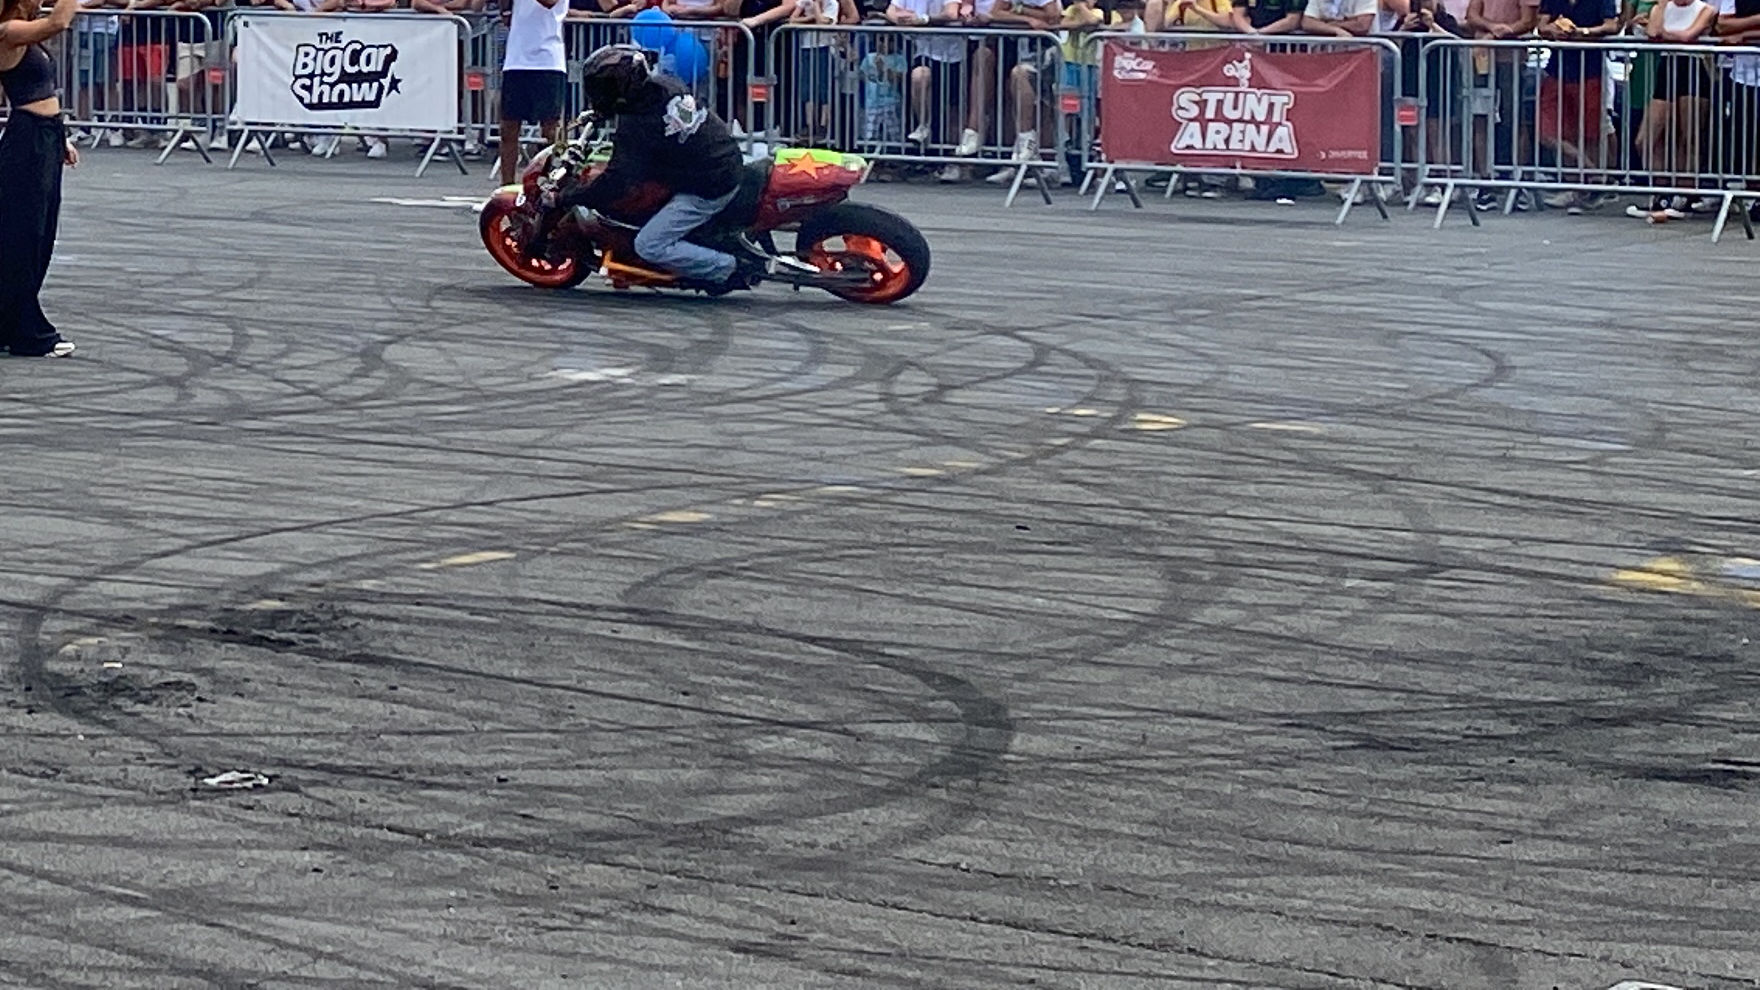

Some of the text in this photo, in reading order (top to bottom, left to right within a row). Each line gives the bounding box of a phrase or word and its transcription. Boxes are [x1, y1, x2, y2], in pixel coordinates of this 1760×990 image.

[317, 30, 344, 44] THE
[292, 76, 382, 104] Show
[1175, 90, 1290, 123] STUNT
[1175, 121, 1293, 154] ARENA
